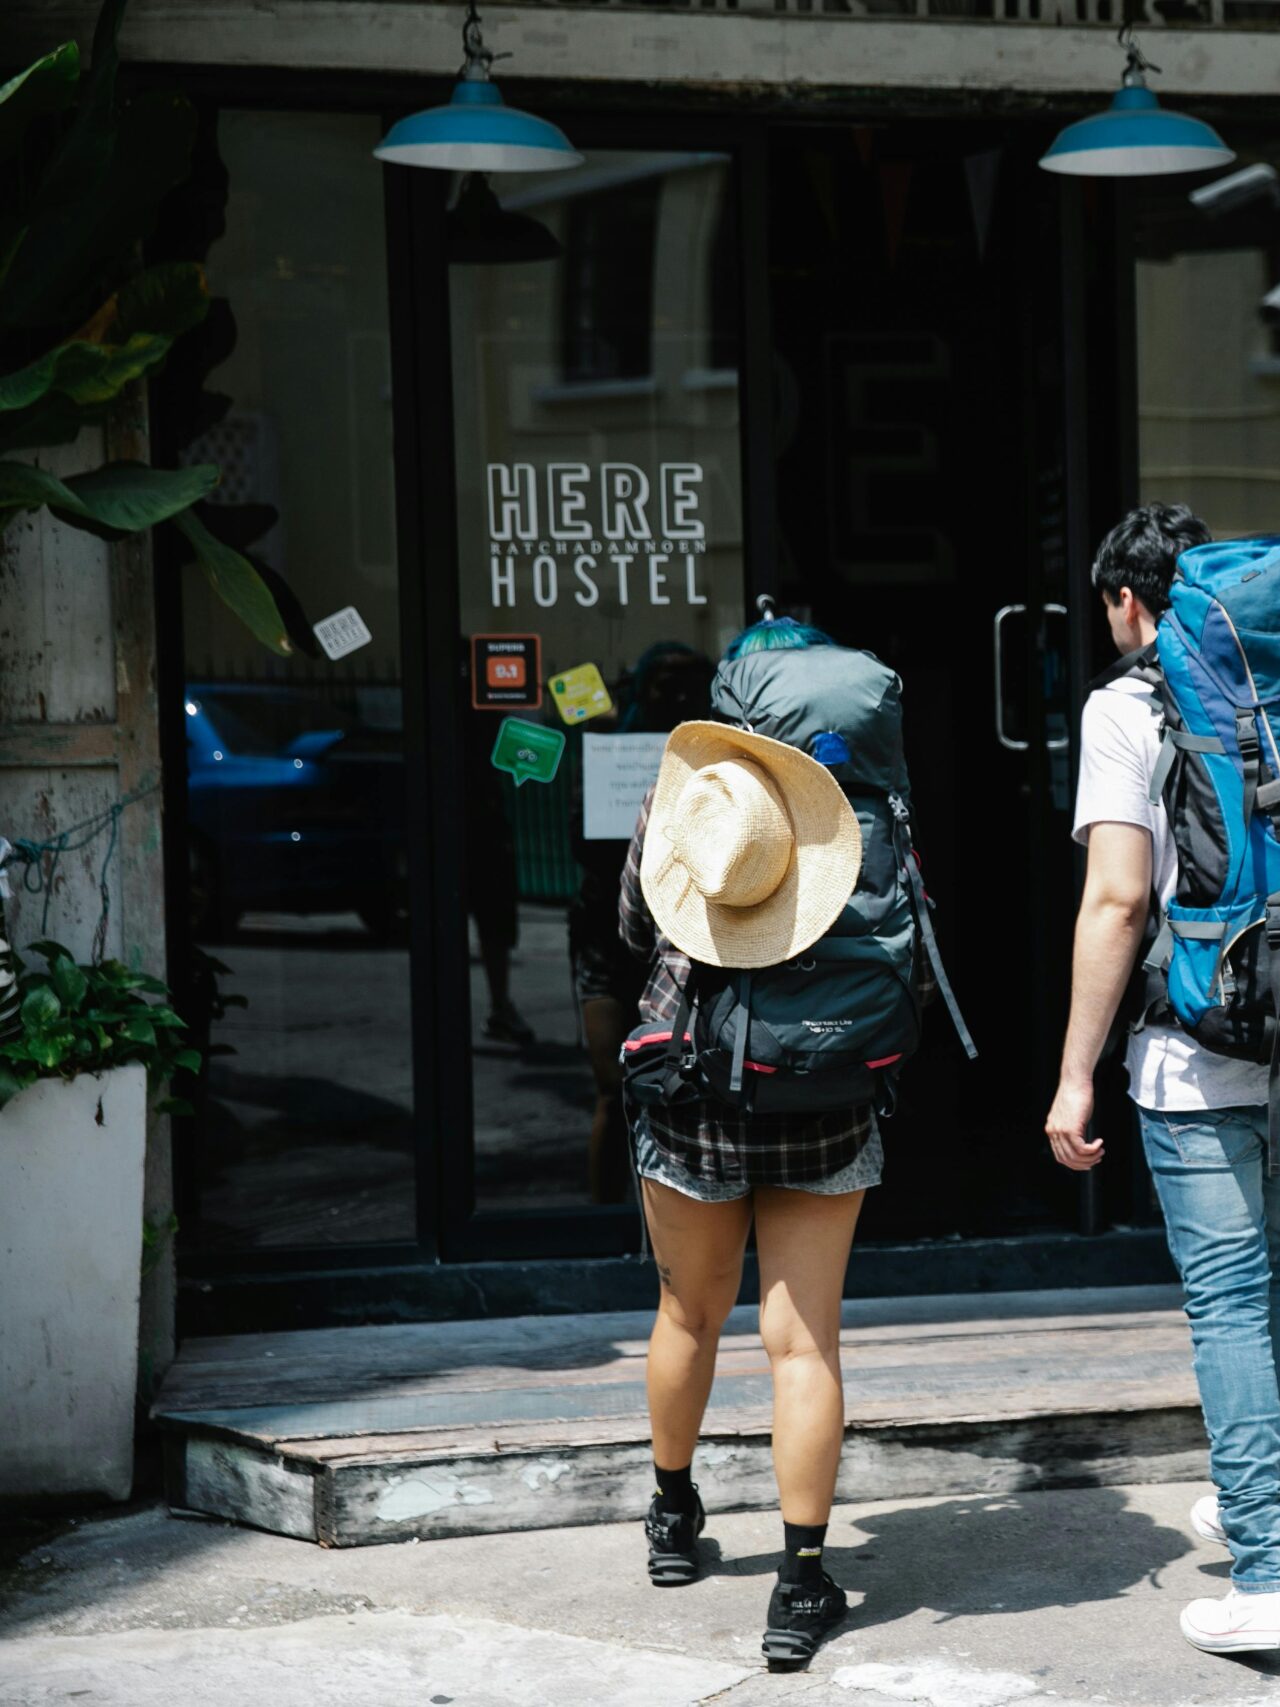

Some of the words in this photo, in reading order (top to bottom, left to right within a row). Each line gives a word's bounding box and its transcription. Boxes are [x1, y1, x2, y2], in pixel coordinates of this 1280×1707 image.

[487, 462, 705, 540] HERE
[490, 540, 707, 555] RATCHADAMNOEN
[491, 554, 708, 607] HOSTEL
[487, 642, 525, 652] SUPERB
